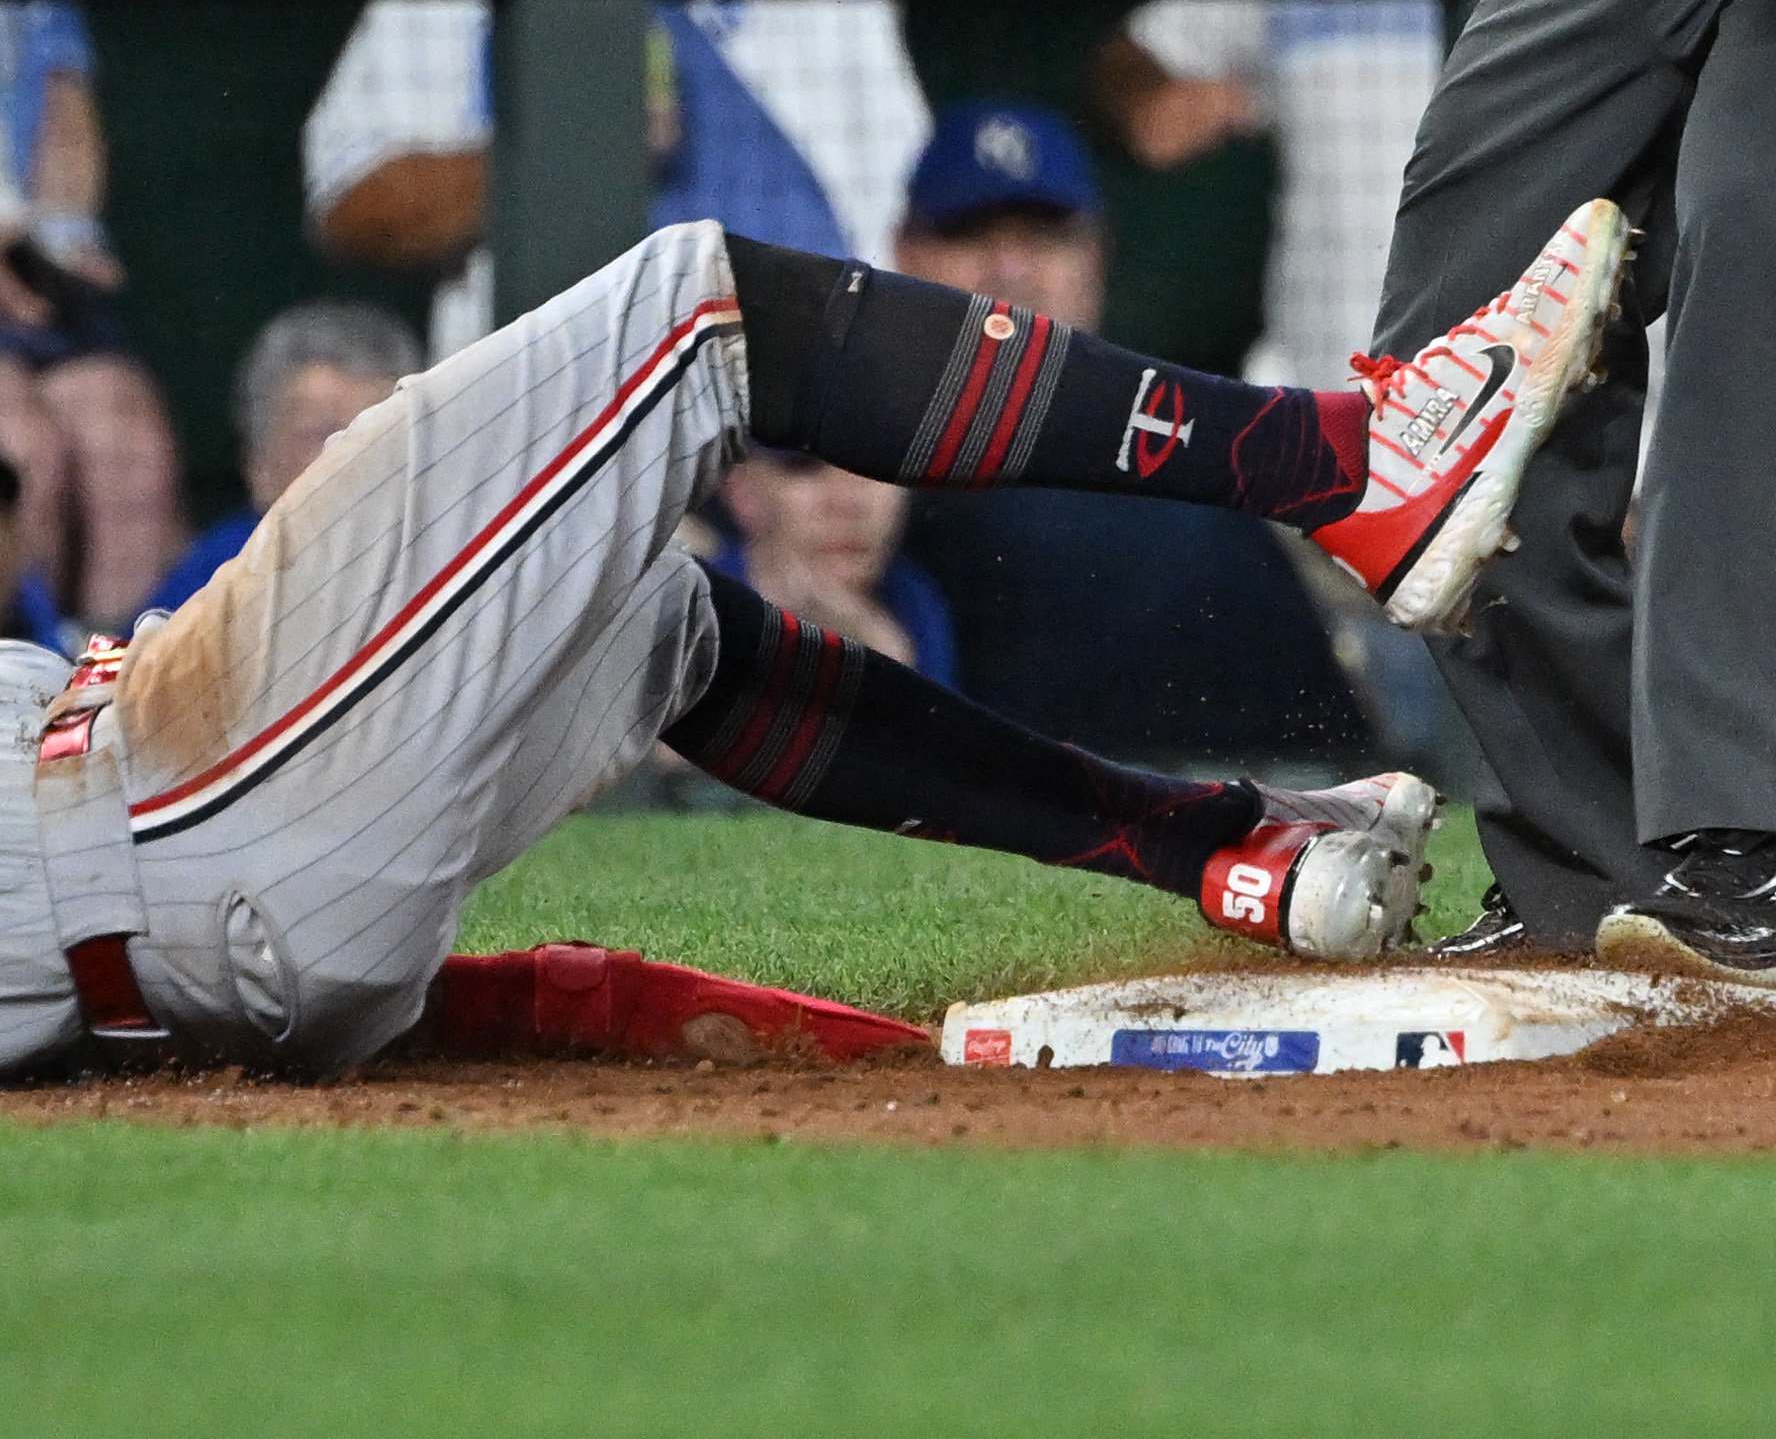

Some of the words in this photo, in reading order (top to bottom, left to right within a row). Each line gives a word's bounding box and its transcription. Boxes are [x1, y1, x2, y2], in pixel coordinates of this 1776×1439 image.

[1115, 367, 1196, 478] TC
[1398, 384, 1461, 459] AMIRA
[1222, 862, 1273, 925] 50
[1221, 1031, 1265, 1071] City
